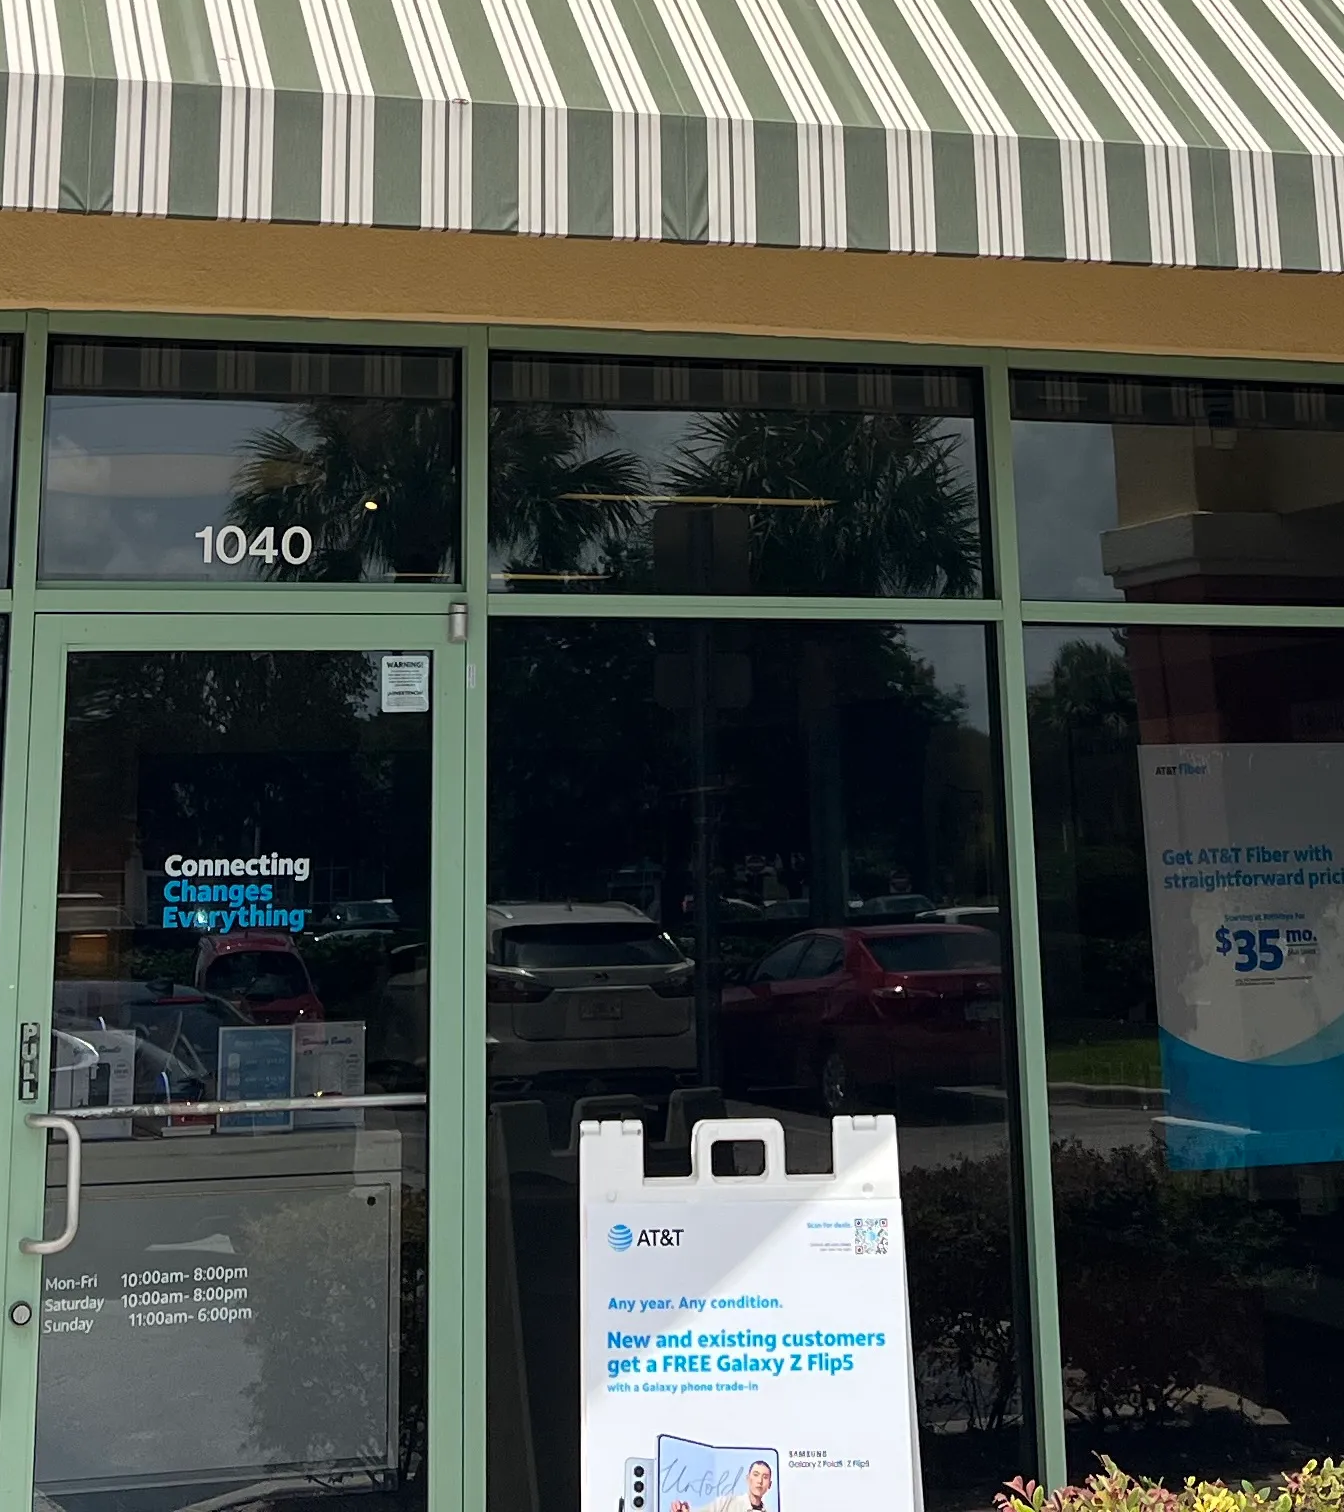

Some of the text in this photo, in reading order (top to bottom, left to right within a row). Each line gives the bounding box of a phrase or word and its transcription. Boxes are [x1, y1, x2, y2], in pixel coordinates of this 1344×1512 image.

[195, 525, 312, 565] 1040
[1155, 766, 1177, 776] AT&T
[164, 852, 311, 881] Connecting
[1162, 844, 1334, 866] Get AT&T Fiber with
[163, 879, 274, 908] Changes
[1163, 868, 1305, 893] straightforward
[1215, 924, 1318, 973] $35 mo.
[21, 1023, 39, 1100] PULL
[636, 1229, 685, 1248] AT&T
[45, 1274, 98, 1291] Mon-Fri
[193, 1266, 248, 1282] 8:00pm
[44, 1294, 105, 1313] Saturday
[193, 1286, 248, 1303] 8:00pm
[607, 1295, 783, 1313] Any year. Any condition.
[42, 1316, 94, 1334] Sunday
[197, 1306, 253, 1324] 6:00pm
[607, 1328, 886, 1353] New and existing customers
[606, 1352, 854, 1379] get a FREE Galaxy Z Flip5
[606, 1380, 759, 1395] with a Galaxy phone trade-in
